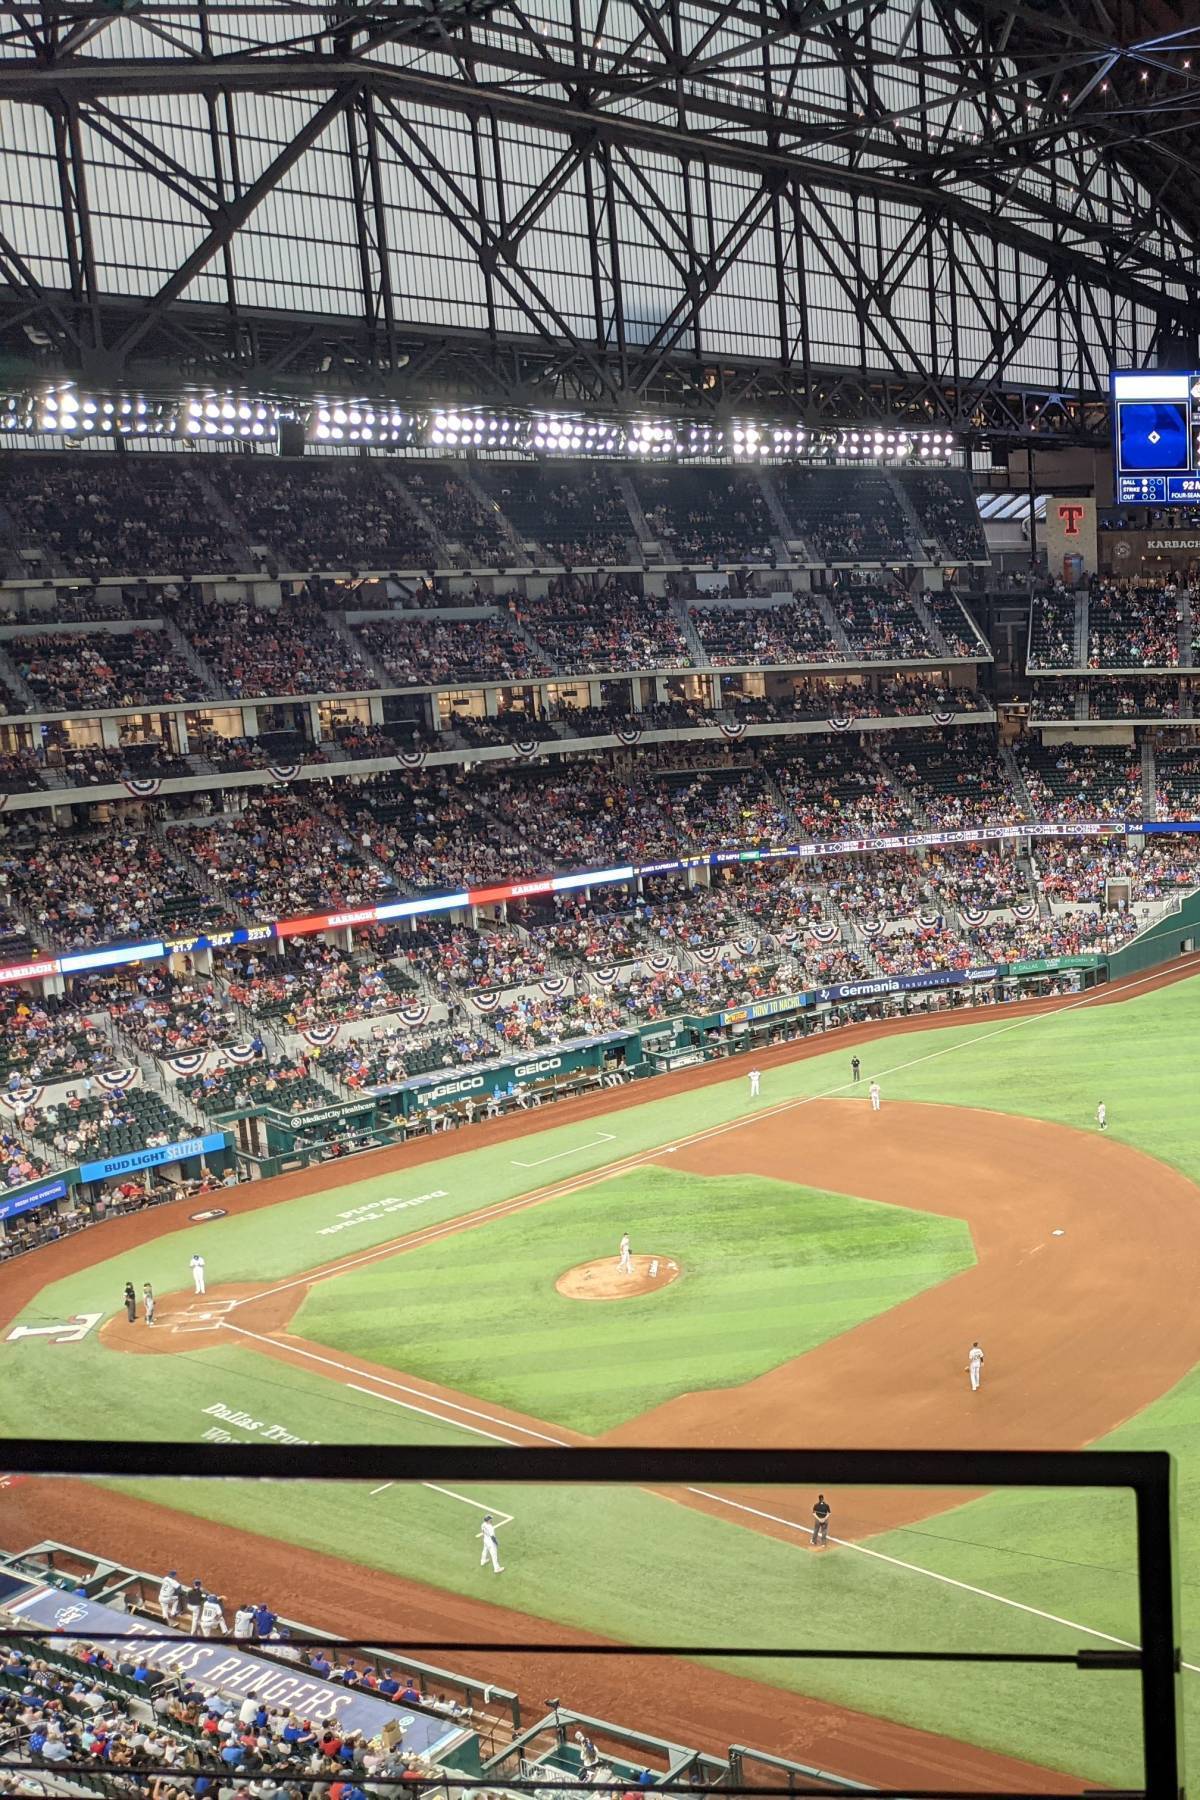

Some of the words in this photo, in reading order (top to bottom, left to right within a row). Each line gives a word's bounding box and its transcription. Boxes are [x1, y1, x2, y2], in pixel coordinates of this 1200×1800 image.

[1182, 481, 1195, 490] 92
[1058, 505, 1084, 536] T
[511, 883, 551, 895] KARBACH
[327, 911, 373, 925] KARBACH
[248, 930, 272, 941] 223.9
[839, 980, 899, 997] Germania
[901, 977, 950, 989] INSURANCE
[752, 1004, 768, 1017] HOW
[769, 1001, 779, 1013] TO
[514, 1058, 562, 1078] GEICO
[434, 1076, 484, 1097] GEICO
[302, 1111, 327, 1125] Medical
[328, 1108, 341, 1121] City
[341, 1101, 377, 1117] Healthcare
[104, 1160, 130, 1173] BUD
[131, 1150, 165, 1167] LIGHT
[166, 1140, 204, 1160] SELTZER
[384, 1190, 449, 1212] Dallas
[200, 1402, 265, 1431] Dallas
[203, 1655, 353, 1720] RANGERS
